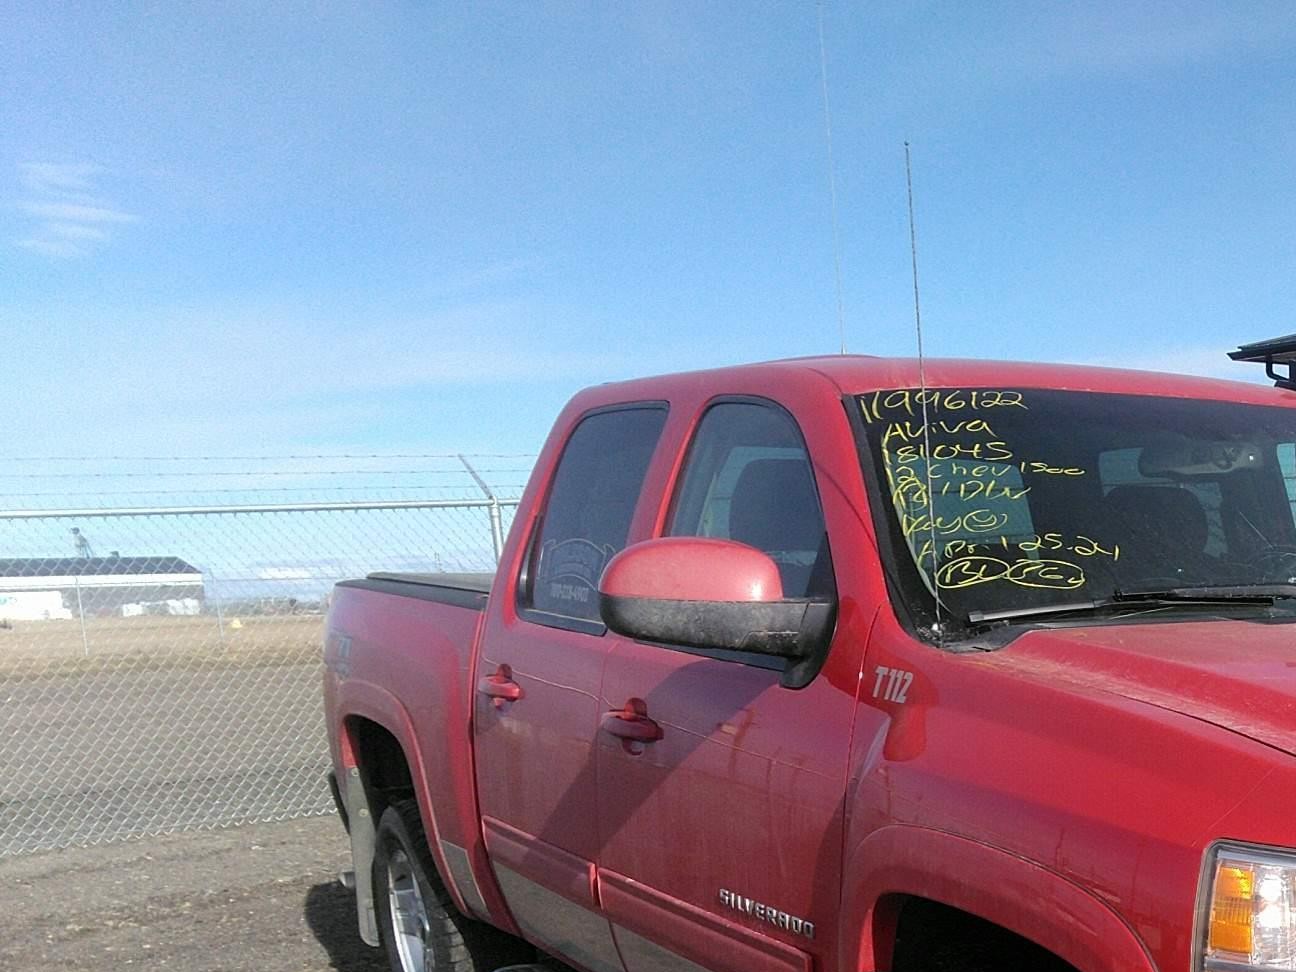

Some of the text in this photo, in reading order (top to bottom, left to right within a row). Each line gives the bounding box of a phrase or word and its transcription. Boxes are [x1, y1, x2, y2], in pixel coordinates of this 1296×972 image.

[860, 391, 1029, 423] 11996122
[881, 420, 998, 451] Aviva
[872, 666, 914, 703] T112
[719, 888, 816, 939] SILVERADO
